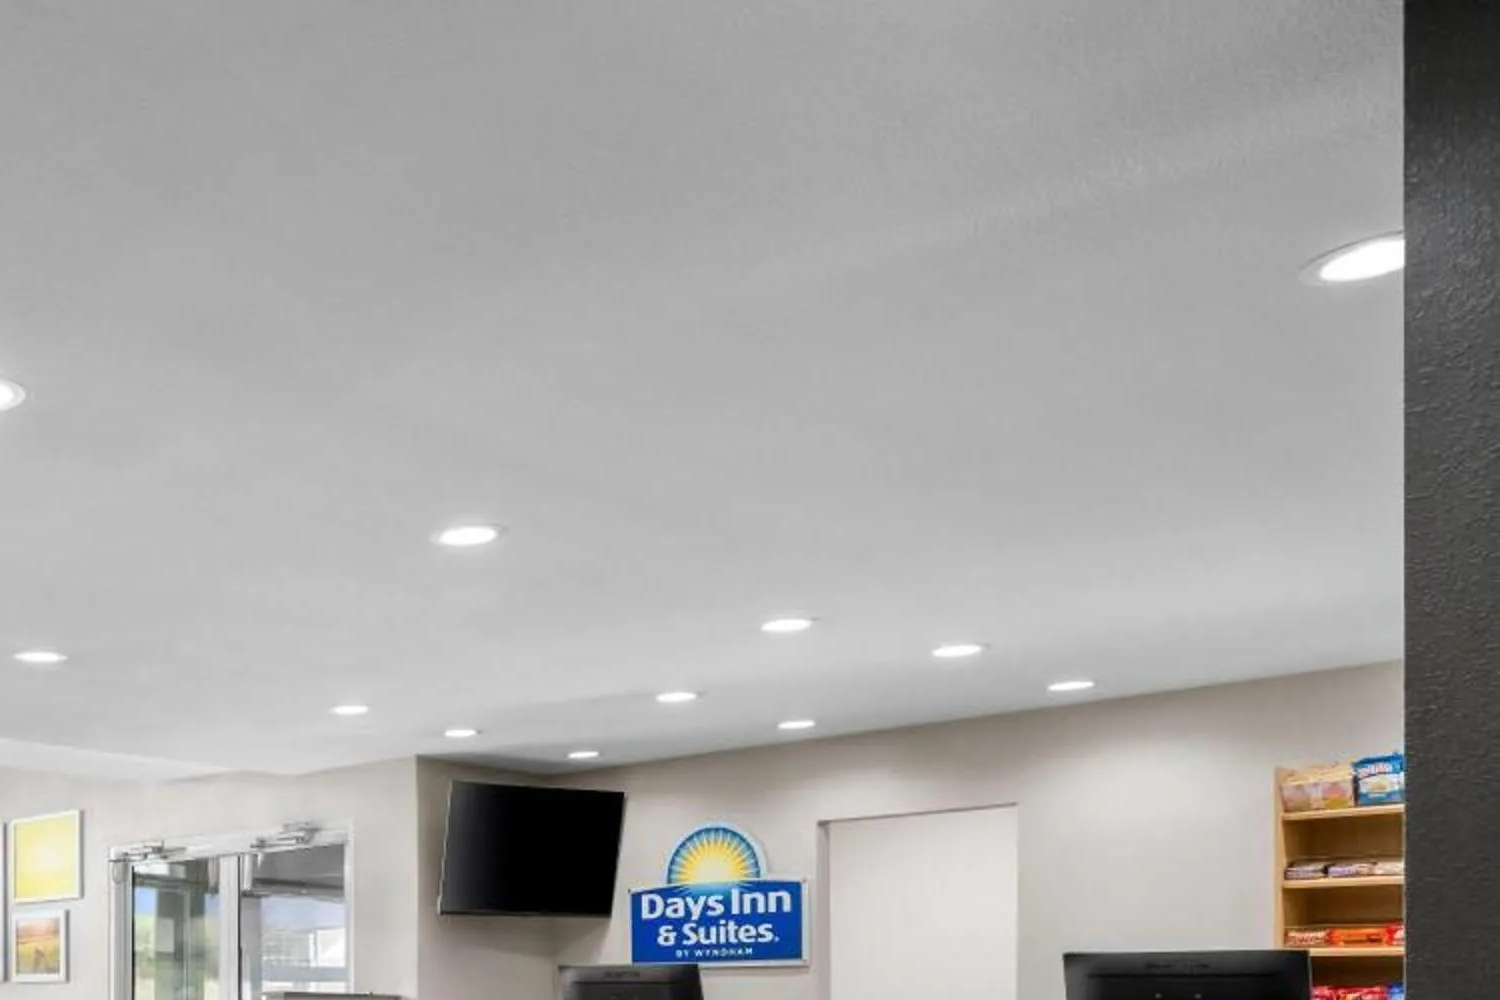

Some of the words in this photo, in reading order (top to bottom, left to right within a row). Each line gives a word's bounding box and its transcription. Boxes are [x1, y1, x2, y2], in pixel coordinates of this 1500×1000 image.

[641, 893, 725, 920] Days
[731, 888, 792, 915] Inn
[657, 925, 676, 946] &
[675, 949, 689, 958] BY
